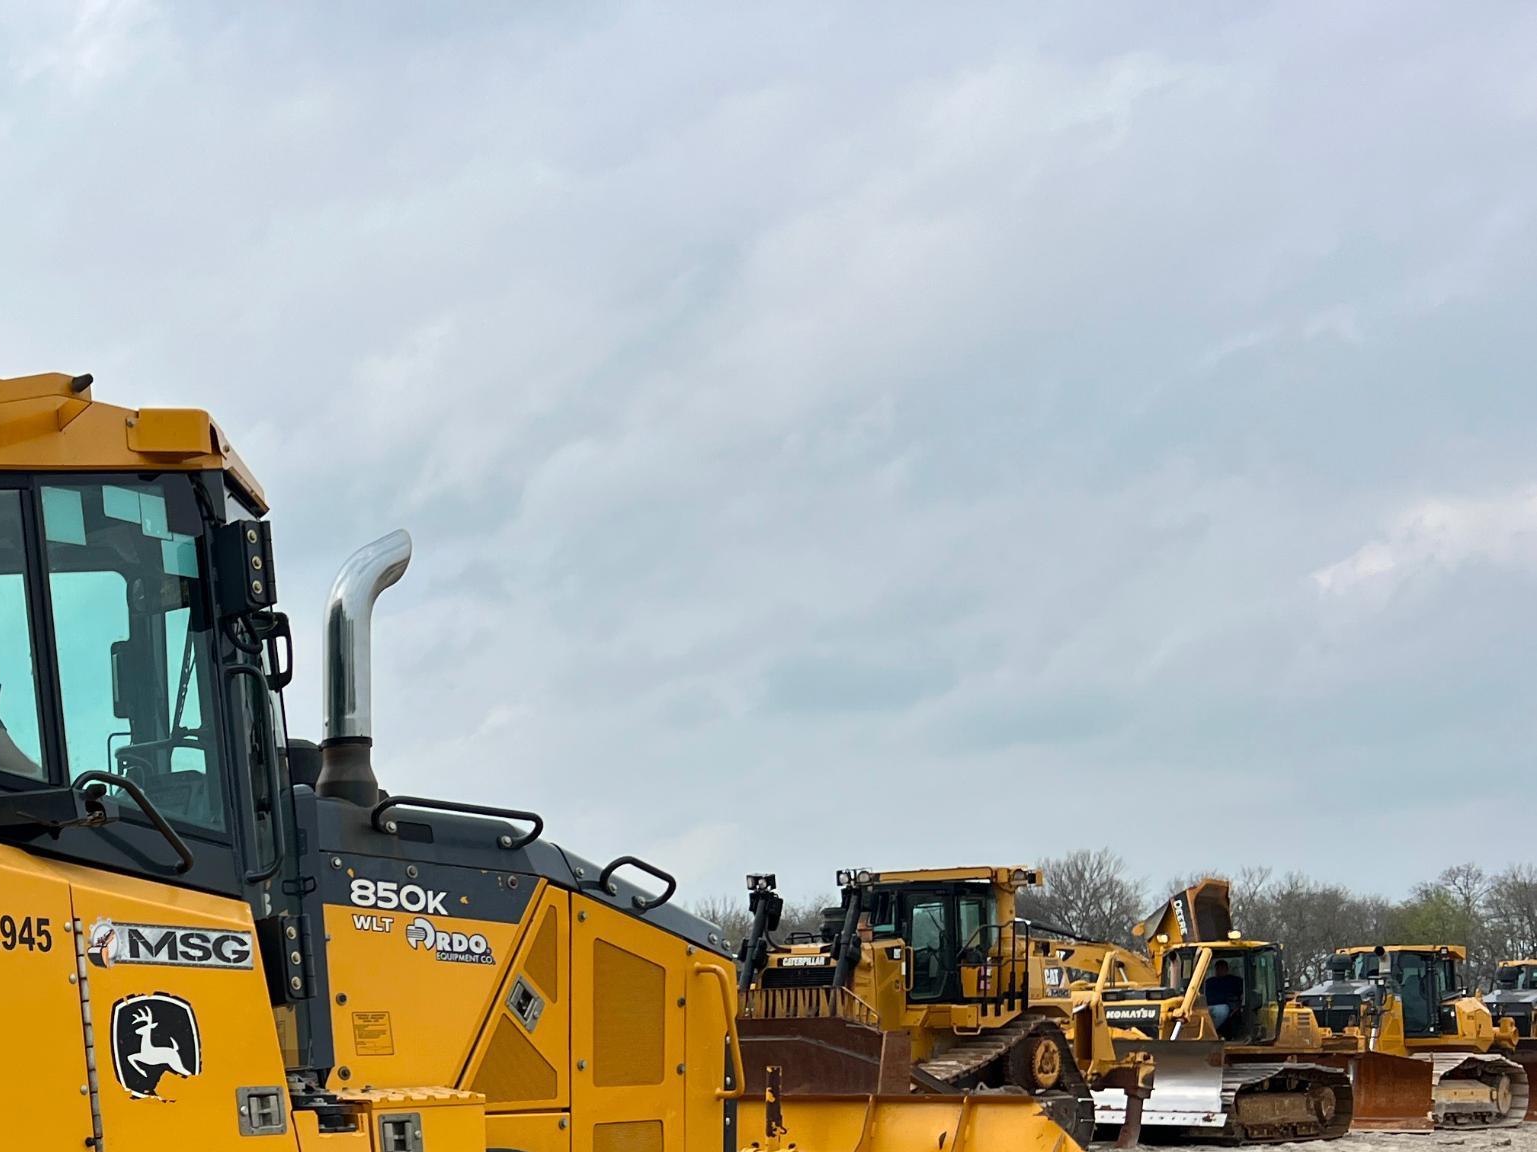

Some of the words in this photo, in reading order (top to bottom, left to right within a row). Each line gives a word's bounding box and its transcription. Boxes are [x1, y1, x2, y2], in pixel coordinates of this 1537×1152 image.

[350, 878, 449, 916] 850K
[352, 914, 394, 933] WLT
[1173, 899, 1188, 936] DEERE
[128, 928, 250, 963] MSG
[436, 951, 479, 963] EQUIPMENT
[782, 956, 825, 967] CATERPILLAR
[1044, 968, 1059, 985] CAT
[1106, 1007, 1156, 1019] KOMATSU
